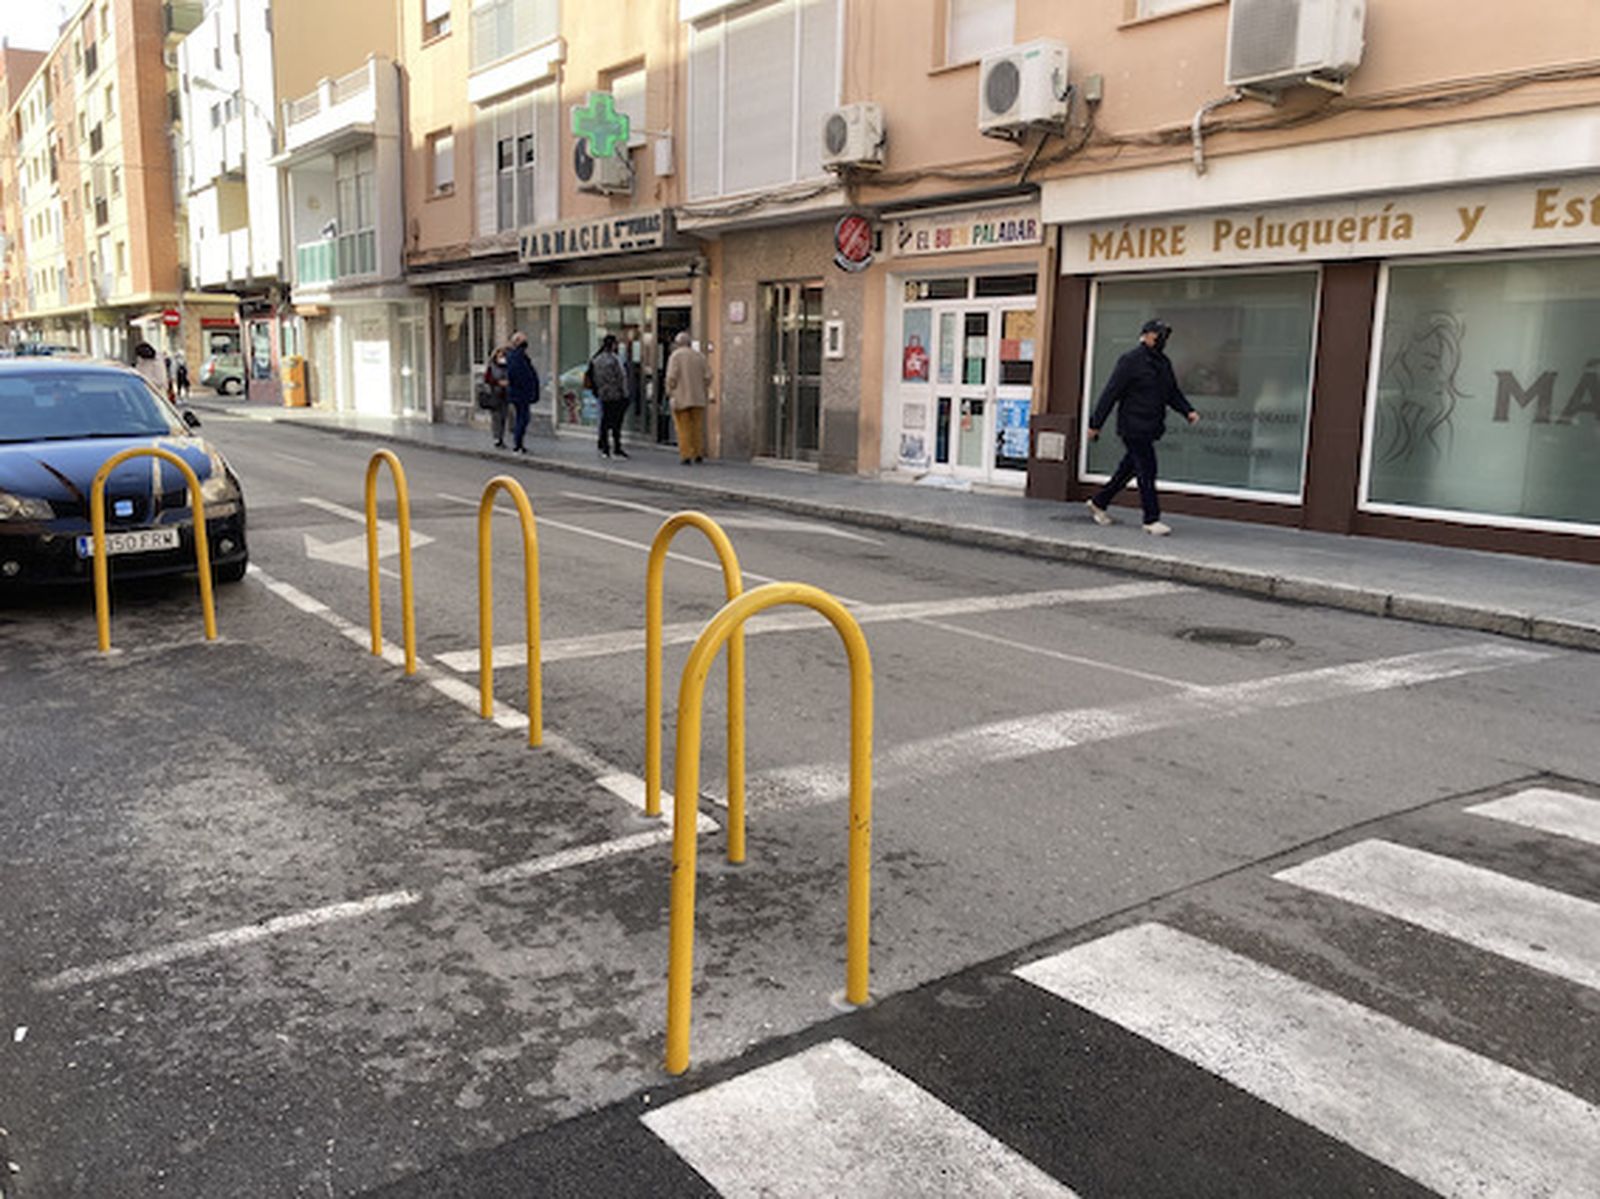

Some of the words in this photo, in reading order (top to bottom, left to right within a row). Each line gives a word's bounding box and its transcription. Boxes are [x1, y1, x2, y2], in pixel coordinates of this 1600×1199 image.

[520, 223, 613, 257] FARMACIA
[972, 219, 1037, 246] PALADAR
[1088, 222, 1186, 261] MÁIRE
[1212, 203, 1413, 252] Peluquería
[1454, 205, 1486, 242] y
